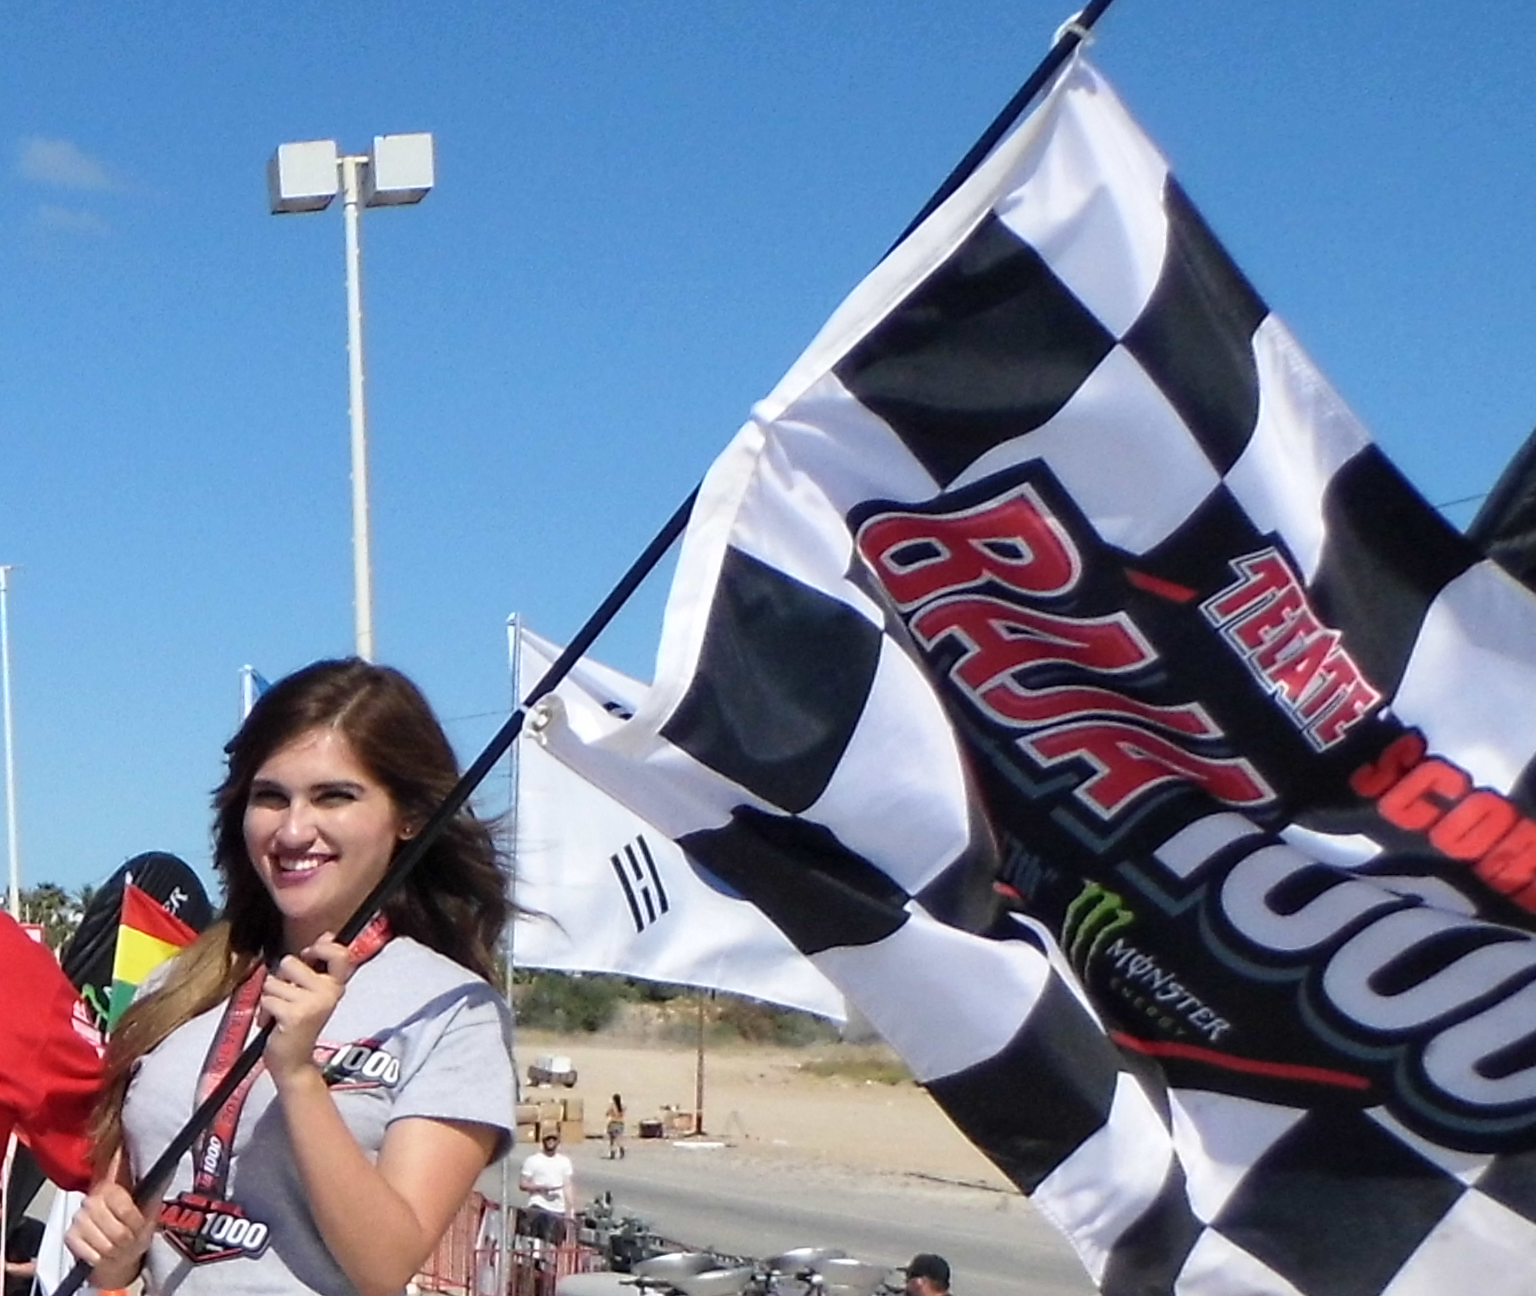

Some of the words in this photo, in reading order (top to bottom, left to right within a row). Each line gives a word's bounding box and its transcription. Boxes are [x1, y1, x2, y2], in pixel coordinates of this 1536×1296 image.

[856, 482, 1277, 820] BAJA
[1198, 546, 1382, 753] TECATE
[1350, 734, 1536, 914] SCOR
[1106, 938, 1232, 1043] MONSTER
[202, 1211, 270, 1249] 1000
